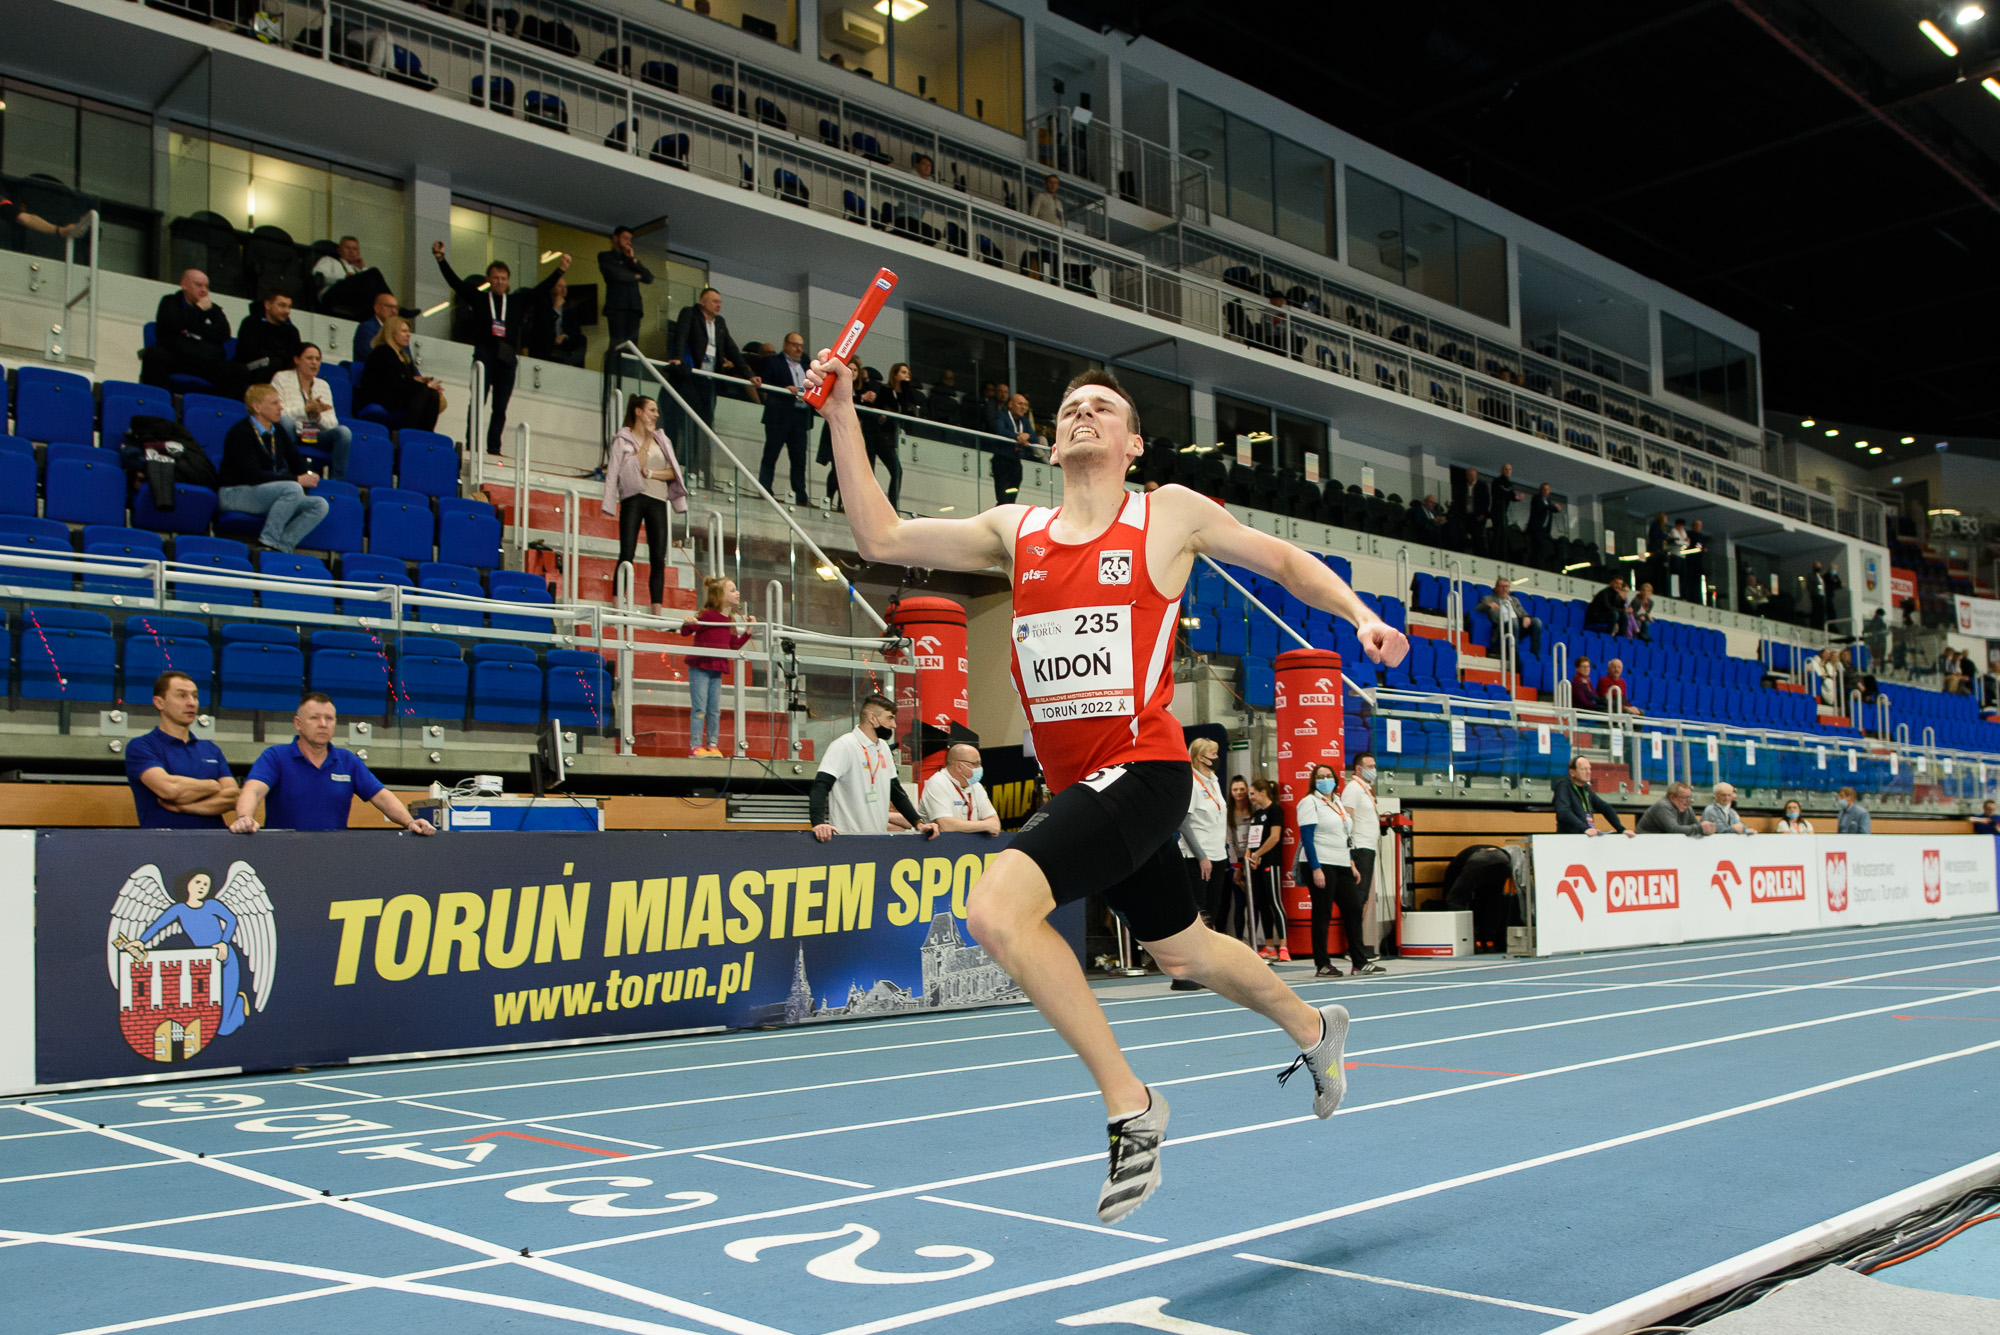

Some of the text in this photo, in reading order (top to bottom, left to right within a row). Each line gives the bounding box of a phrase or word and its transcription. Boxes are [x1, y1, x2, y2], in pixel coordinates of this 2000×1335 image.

[1021, 569, 1041, 584] pts
[1031, 613, 1119, 638] TORUŃ 235
[1033, 647, 1111, 683] KIDOŃ
[1042, 701, 1112, 718] TORUŃ 2022
[1301, 696, 1333, 704] ORLEN
[434, 810, 441, 826] 2
[1609, 873, 1677, 909] ORLEN
[1752, 869, 1802, 899] ORLEN
[329, 862, 591, 986] TORUŃ
[604, 862, 876, 957] MIASTEM
[494, 952, 755, 1027] www.torun.pl
[504, 1176, 719, 1218] 3
[723, 1223, 995, 1285] 2
